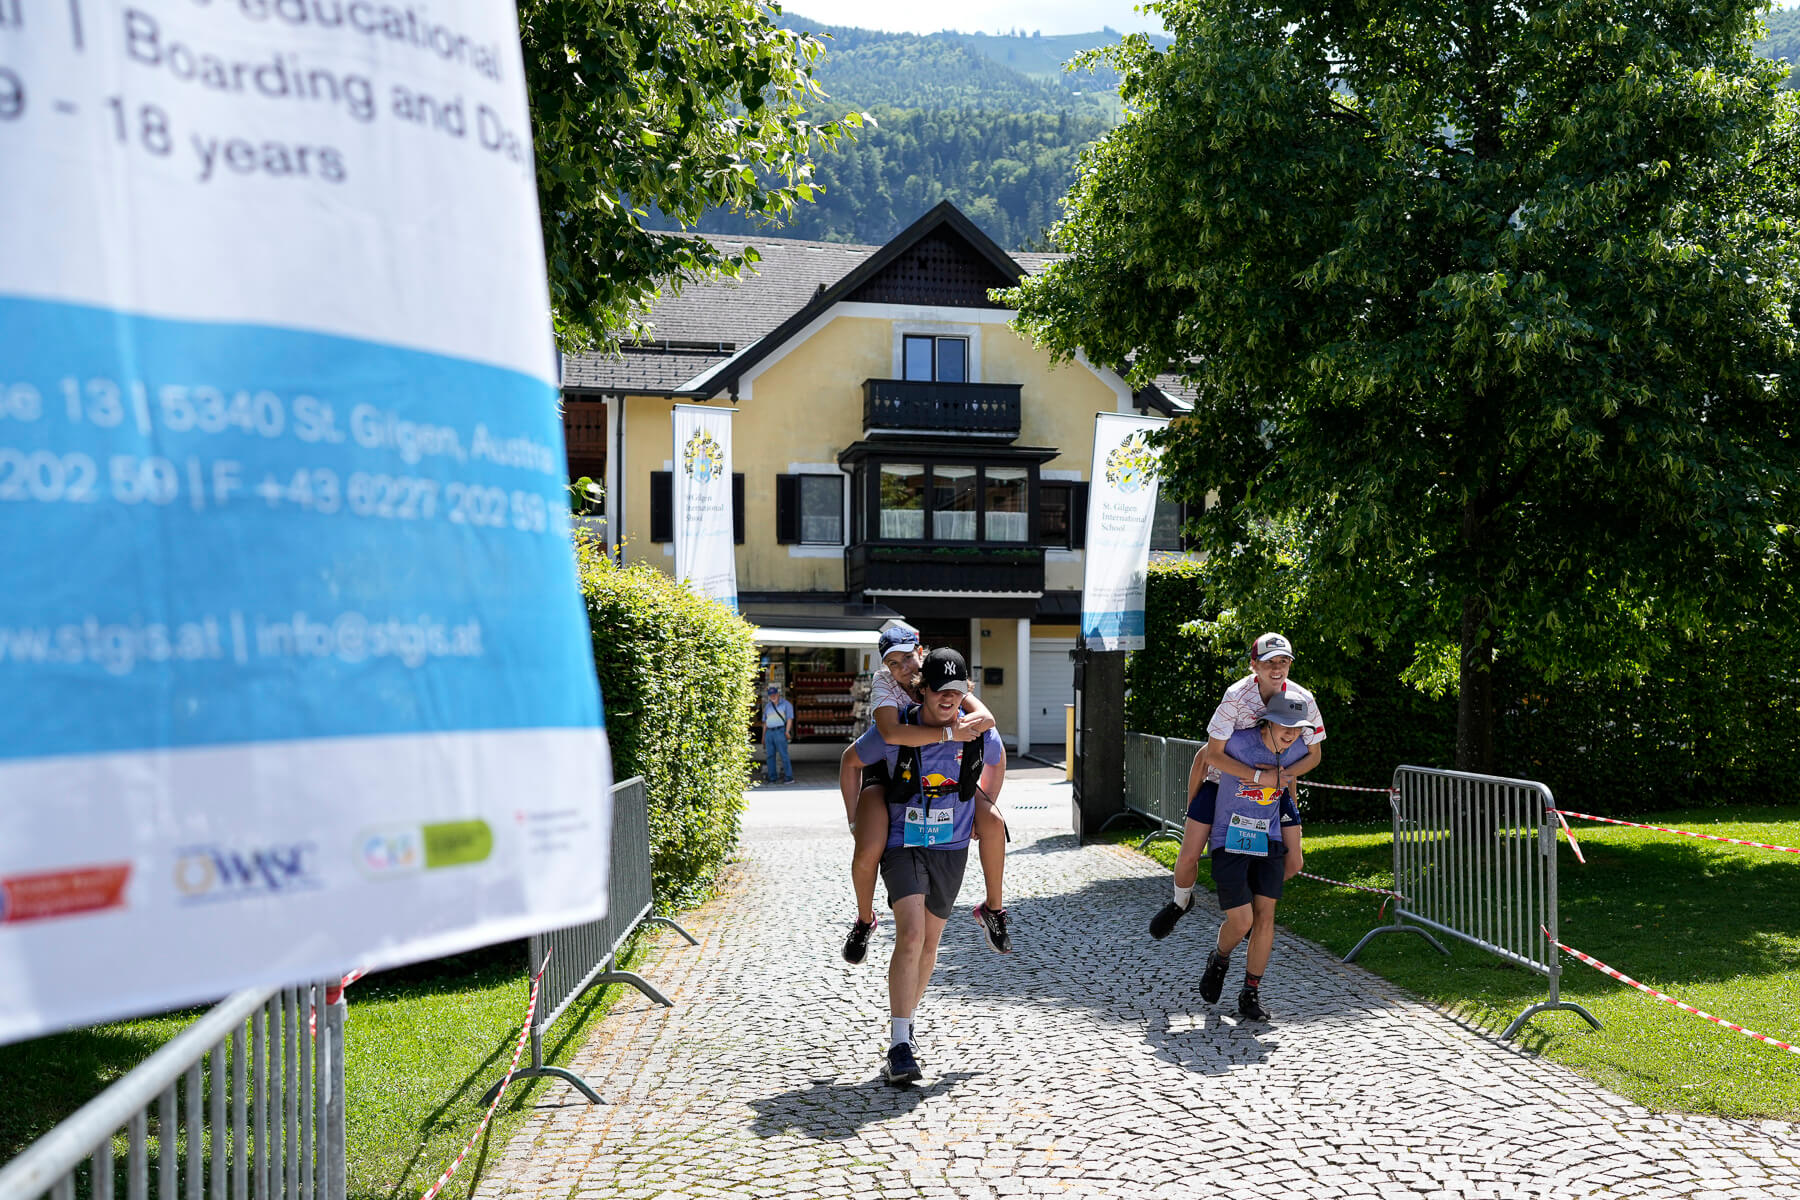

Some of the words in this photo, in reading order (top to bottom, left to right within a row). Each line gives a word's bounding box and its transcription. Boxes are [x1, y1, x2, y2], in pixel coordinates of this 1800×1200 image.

[123, 7, 377, 124] Boarding
[391, 84, 467, 139] and
[105, 95, 173, 156] 18
[190, 134, 347, 183] years
[59, 375, 124, 428] 13
[158, 384, 285, 438] 5340
[292, 394, 346, 443] St.
[212, 458, 242, 507] F
[1113, 503, 1137, 513] Gilgen
[1101, 523, 1126, 532] School
[0, 613, 224, 675] w.stgis.at
[256, 609, 484, 668] info@stgis.at
[944, 660, 958, 676] NY
[1236, 837, 1252, 850] 13
[1239, 830, 1257, 839] TEAM
